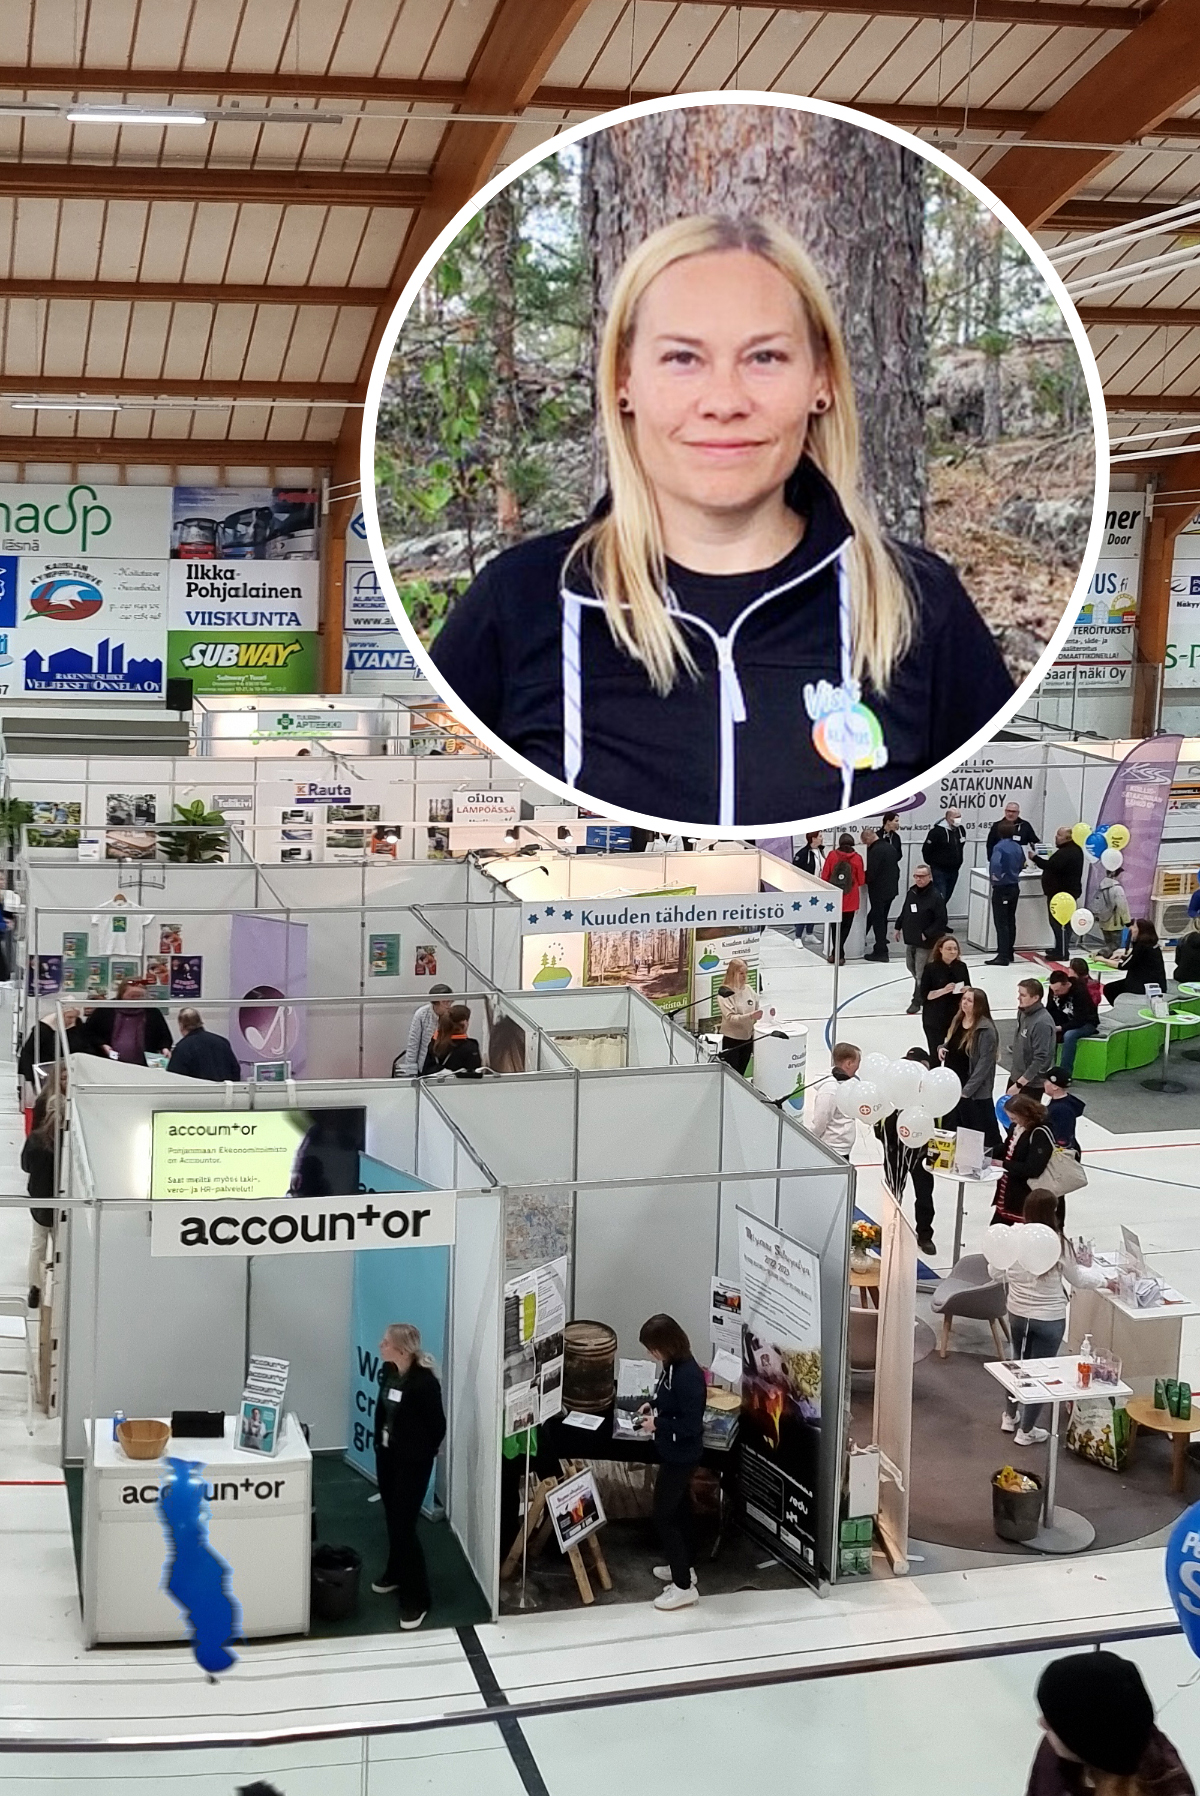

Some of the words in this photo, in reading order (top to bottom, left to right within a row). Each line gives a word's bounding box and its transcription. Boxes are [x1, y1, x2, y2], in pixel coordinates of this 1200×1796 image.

[2, 539, 40, 552] läsnä
[1107, 533, 1132, 545] Door
[186, 564, 241, 580] Ilkka-
[186, 582, 302, 602] Pohjalainen
[186, 611, 302, 626] VIISKUNTA
[1073, 626, 1131, 635] TEROITUKSET
[181, 639, 304, 670] SUBWAY
[352, 651, 418, 668] VANE
[1109, 667, 1127, 681] Oy
[308, 783, 351, 796] Rauta
[940, 776, 1033, 791] SATAKUNNAN
[940, 792, 986, 809] SÄHKÖ
[989, 794, 1007, 808] OY
[581, 907, 650, 927] Kuuden
[654, 905, 718, 924] tähden
[722, 904, 785, 921] reitistö
[191, 1186, 198, 1194] ja
[180, 1204, 431, 1246] accountor
[122, 1477, 286, 1505] accuntor
